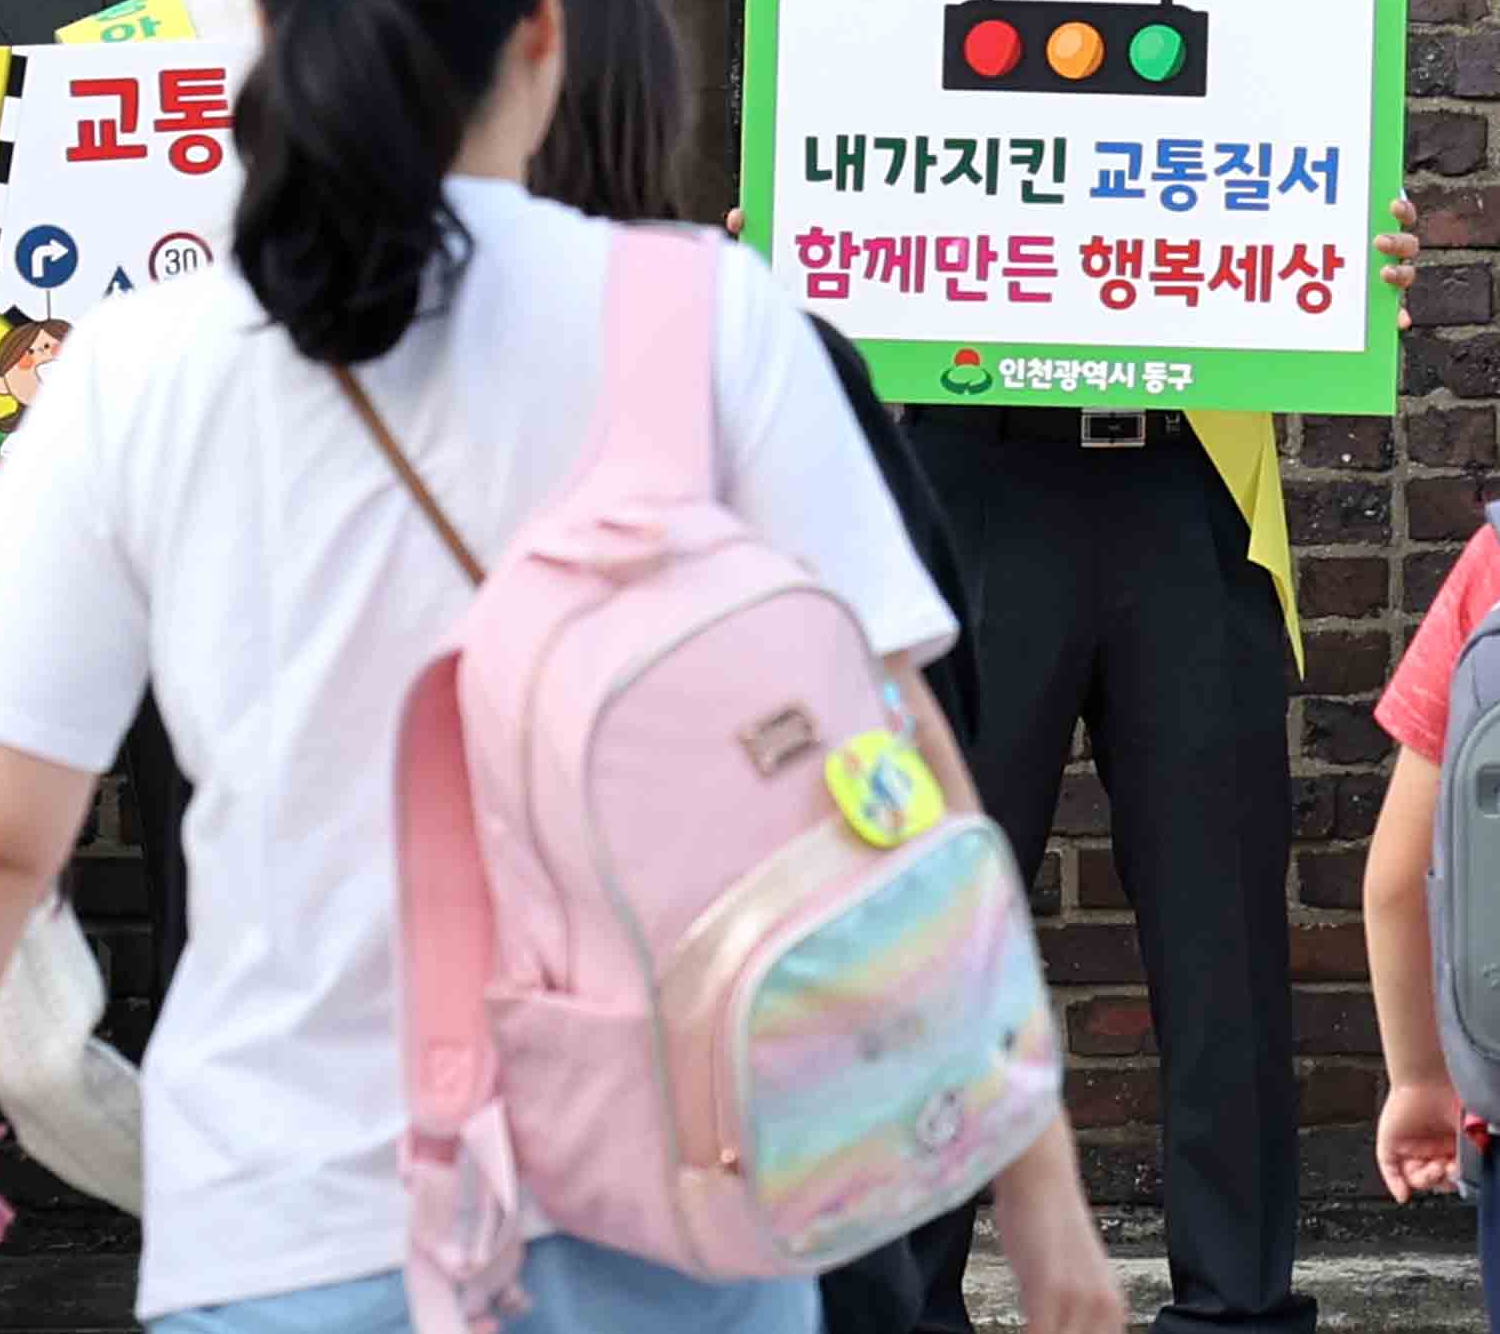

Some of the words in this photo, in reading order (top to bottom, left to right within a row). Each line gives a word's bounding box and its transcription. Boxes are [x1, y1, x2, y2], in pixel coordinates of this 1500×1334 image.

[65, 67, 235, 175] 교통
[804, 133, 1067, 204] 내가지킨
[1088, 139, 1340, 211] 교통질서
[795, 225, 1058, 301] 함께만든
[1079, 235, 1345, 314] 행복세상
[999, 357, 1135, 394] 인천광역시
[1142, 360, 1194, 394] 동구
